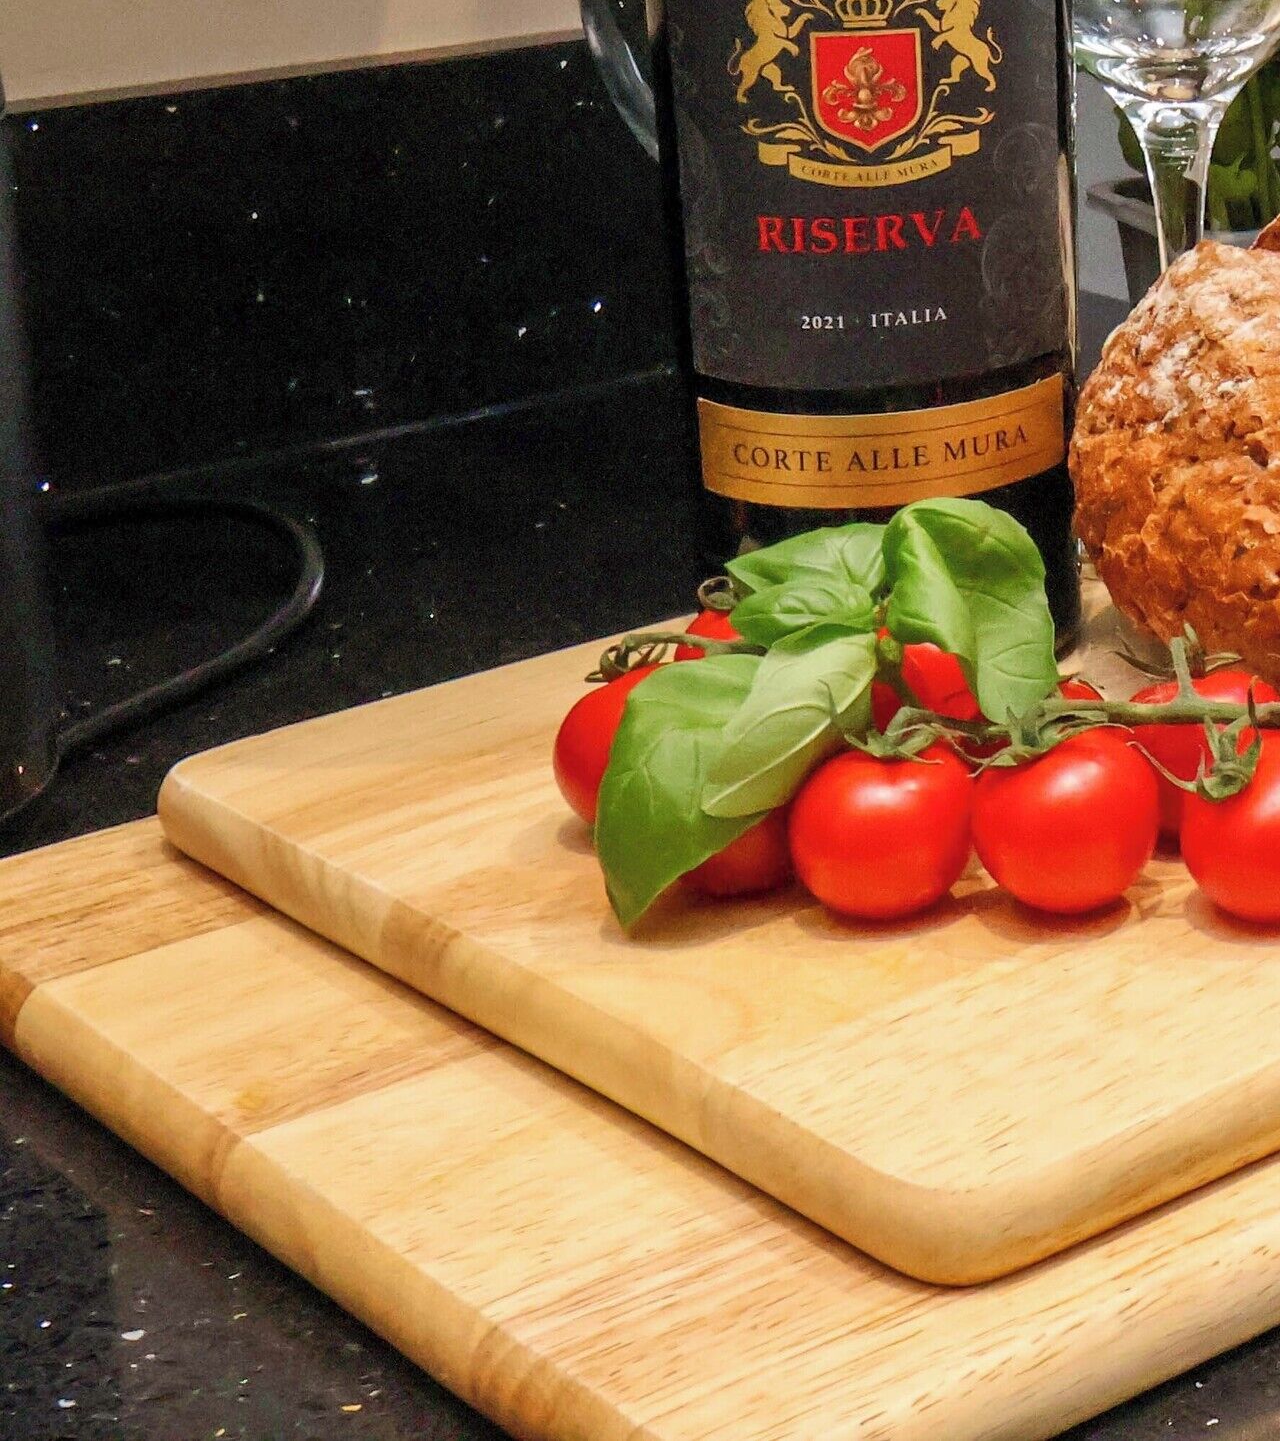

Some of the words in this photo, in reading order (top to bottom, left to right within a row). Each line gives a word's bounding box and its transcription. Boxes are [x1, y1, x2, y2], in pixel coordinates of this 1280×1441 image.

[801, 165, 848, 182] CORTE
[855, 170, 890, 182] ALLE
[898, 159, 938, 177] MURA
[757, 207, 982, 254] RISERVA
[801, 315, 845, 330] 2021
[870, 307, 948, 328] ITALIA
[733, 443, 833, 473] CORTE
[845, 445, 931, 472] ALLE
[944, 425, 1029, 463] MURA
